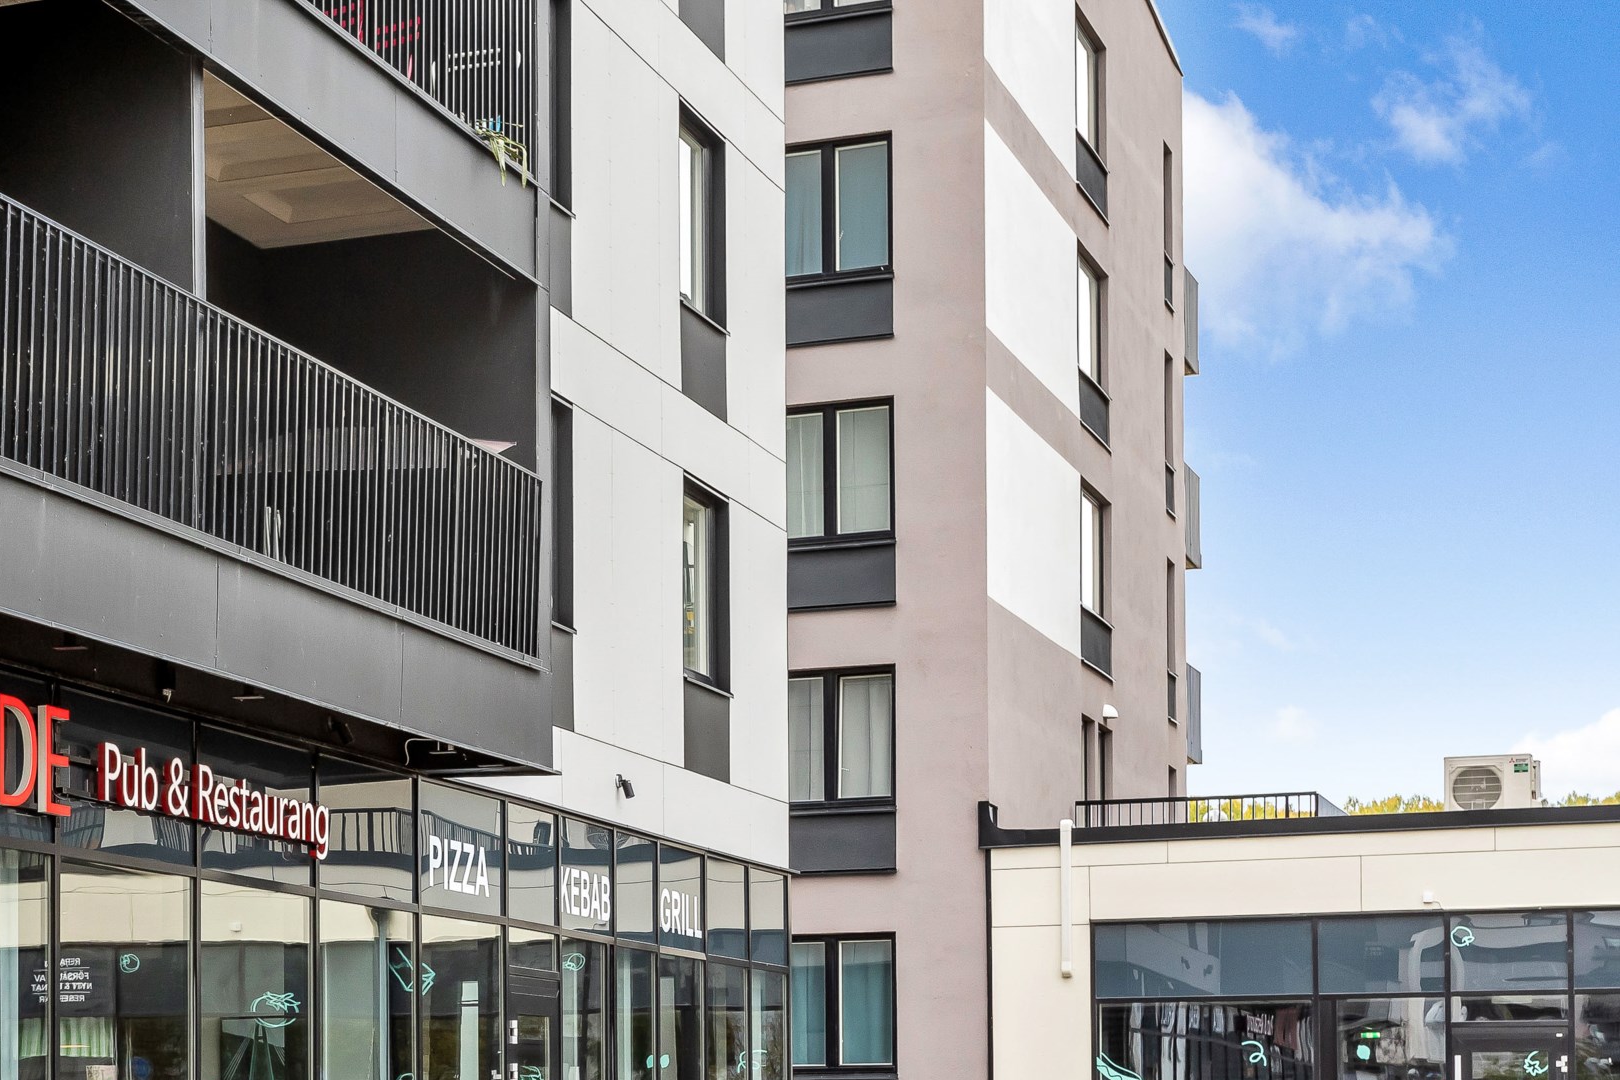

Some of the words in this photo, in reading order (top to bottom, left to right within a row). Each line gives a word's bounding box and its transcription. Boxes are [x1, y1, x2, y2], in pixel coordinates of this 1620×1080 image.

[97, 742, 157, 812] Pub
[163, 757, 191, 818] &
[193, 763, 330, 861] Restaurang
[429, 835, 490, 898] PIZZA
[560, 866, 611, 922] KEBAB
[660, 888, 702, 939] GRILL
